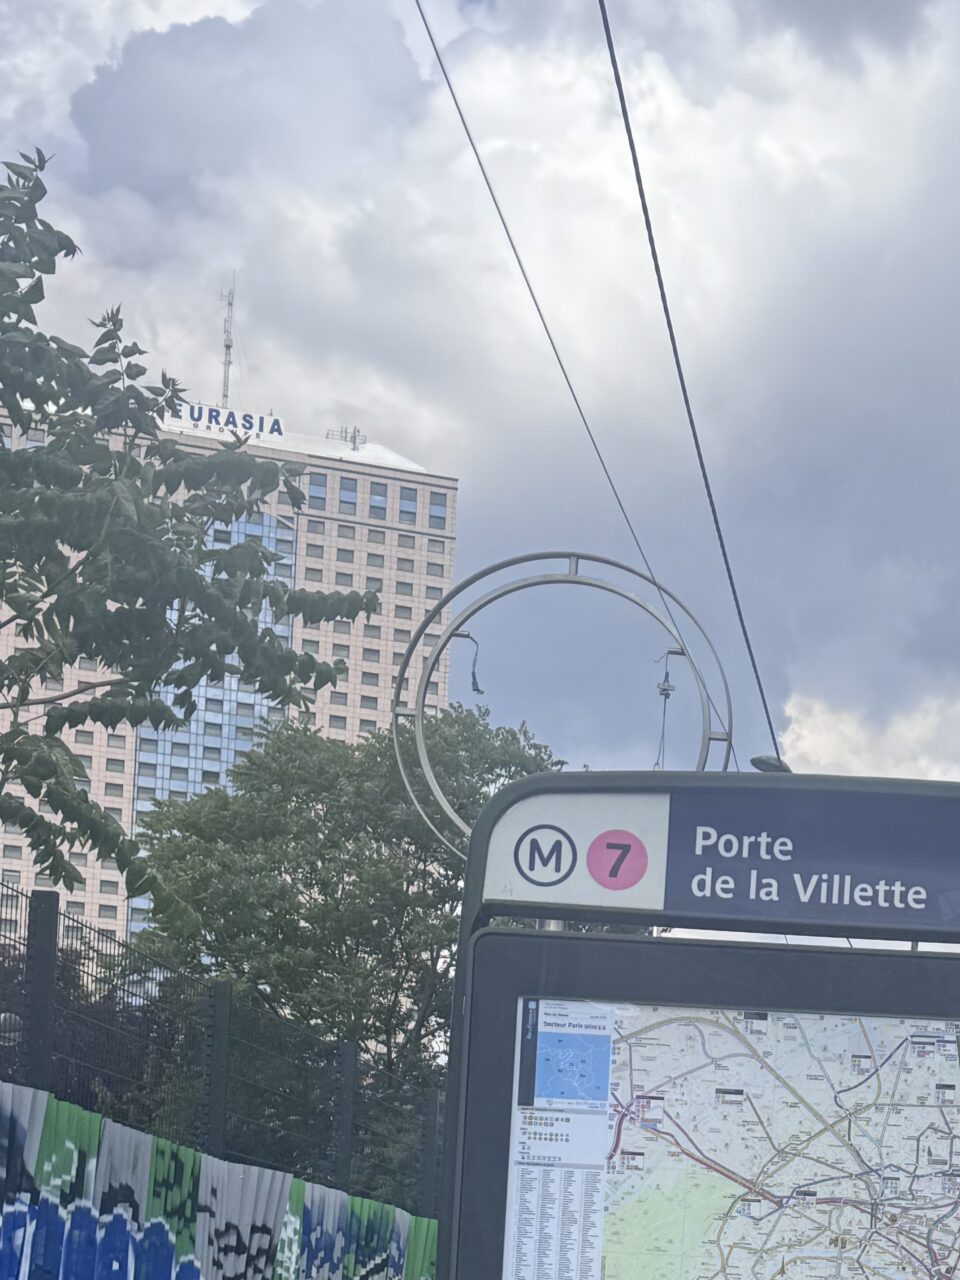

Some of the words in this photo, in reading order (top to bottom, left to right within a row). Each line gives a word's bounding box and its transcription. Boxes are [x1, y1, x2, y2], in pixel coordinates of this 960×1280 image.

[171, 402, 283, 436] EURASIA
[605, 842, 631, 878] 7
[694, 826, 794, 860] Porte
[691, 867, 735, 898] de
[749, 869, 779, 901] la
[793, 873, 927, 909] Villette
